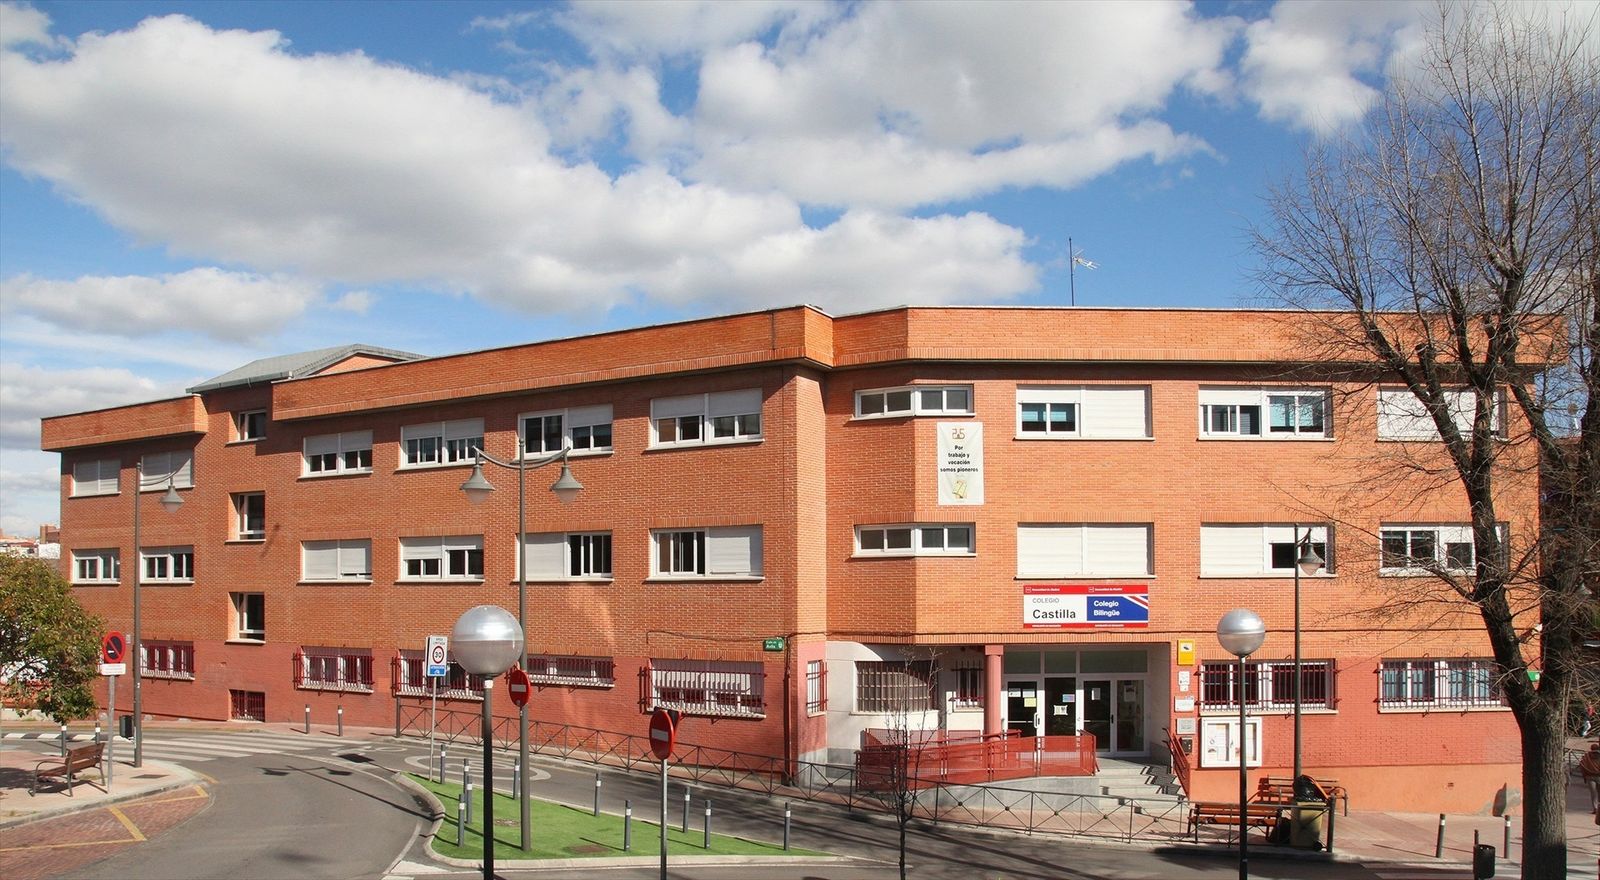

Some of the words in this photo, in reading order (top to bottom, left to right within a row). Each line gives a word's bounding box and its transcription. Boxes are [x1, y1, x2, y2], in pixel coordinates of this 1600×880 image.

[1093, 600, 1119, 608] Colegio
[1032, 609, 1076, 619] Castilla
[1093, 609, 1120, 617] Bilingüe
[434, 651, 442, 659] 30
